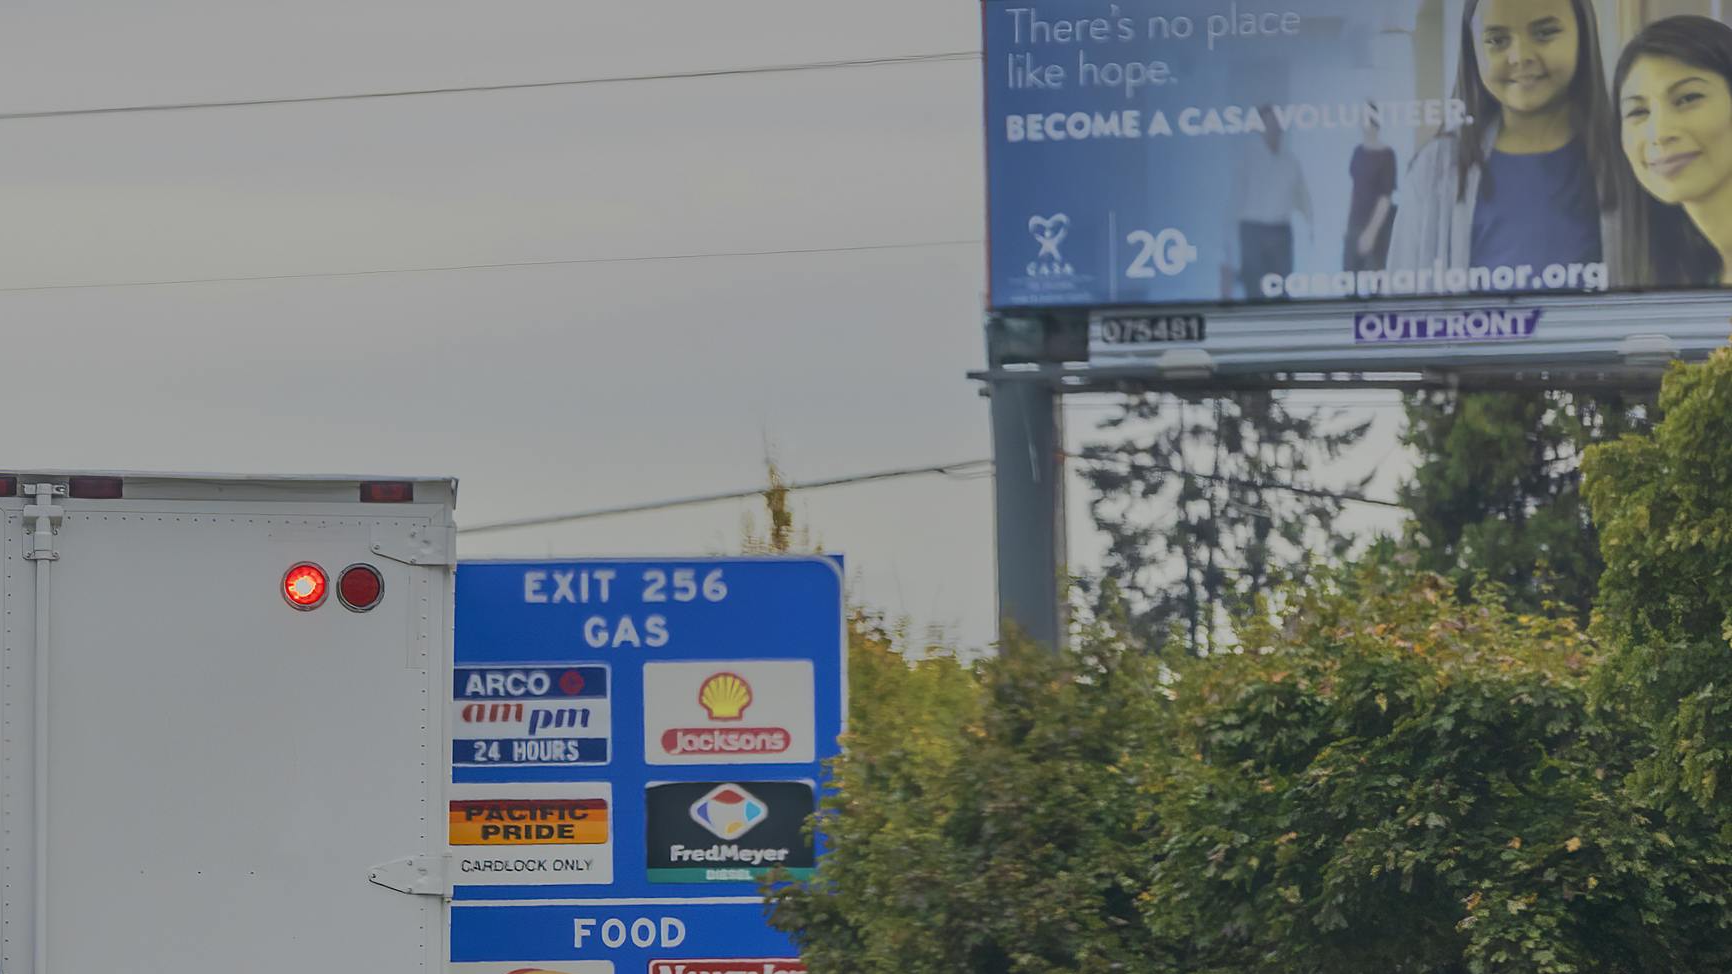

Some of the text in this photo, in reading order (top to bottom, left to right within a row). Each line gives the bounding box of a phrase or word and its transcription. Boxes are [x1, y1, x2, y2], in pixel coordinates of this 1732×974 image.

[1005, 1, 1301, 50] There's no place
[1007, 50, 1178, 98] like hope.
[1006, 98, 1474, 142] BECOME A CASA VOLUNTEER.
[1261, 258, 1609, 298] casamarionor.org
[1359, 309, 1533, 340] OUTFRONT
[524, 569, 728, 603] EXIT 256
[583, 615, 669, 648] GAS
[465, 671, 551, 696] ARCO
[462, 703, 590, 736] am pm
[473, 740, 580, 761] 24 HOURS
[672, 729, 786, 754] Jacksons
[465, 805, 589, 822] PACIFIC
[481, 824, 575, 840] PRIDE
[461, 858, 594, 873] CARDLOCK ONLY
[574, 917, 685, 948] FOOD
